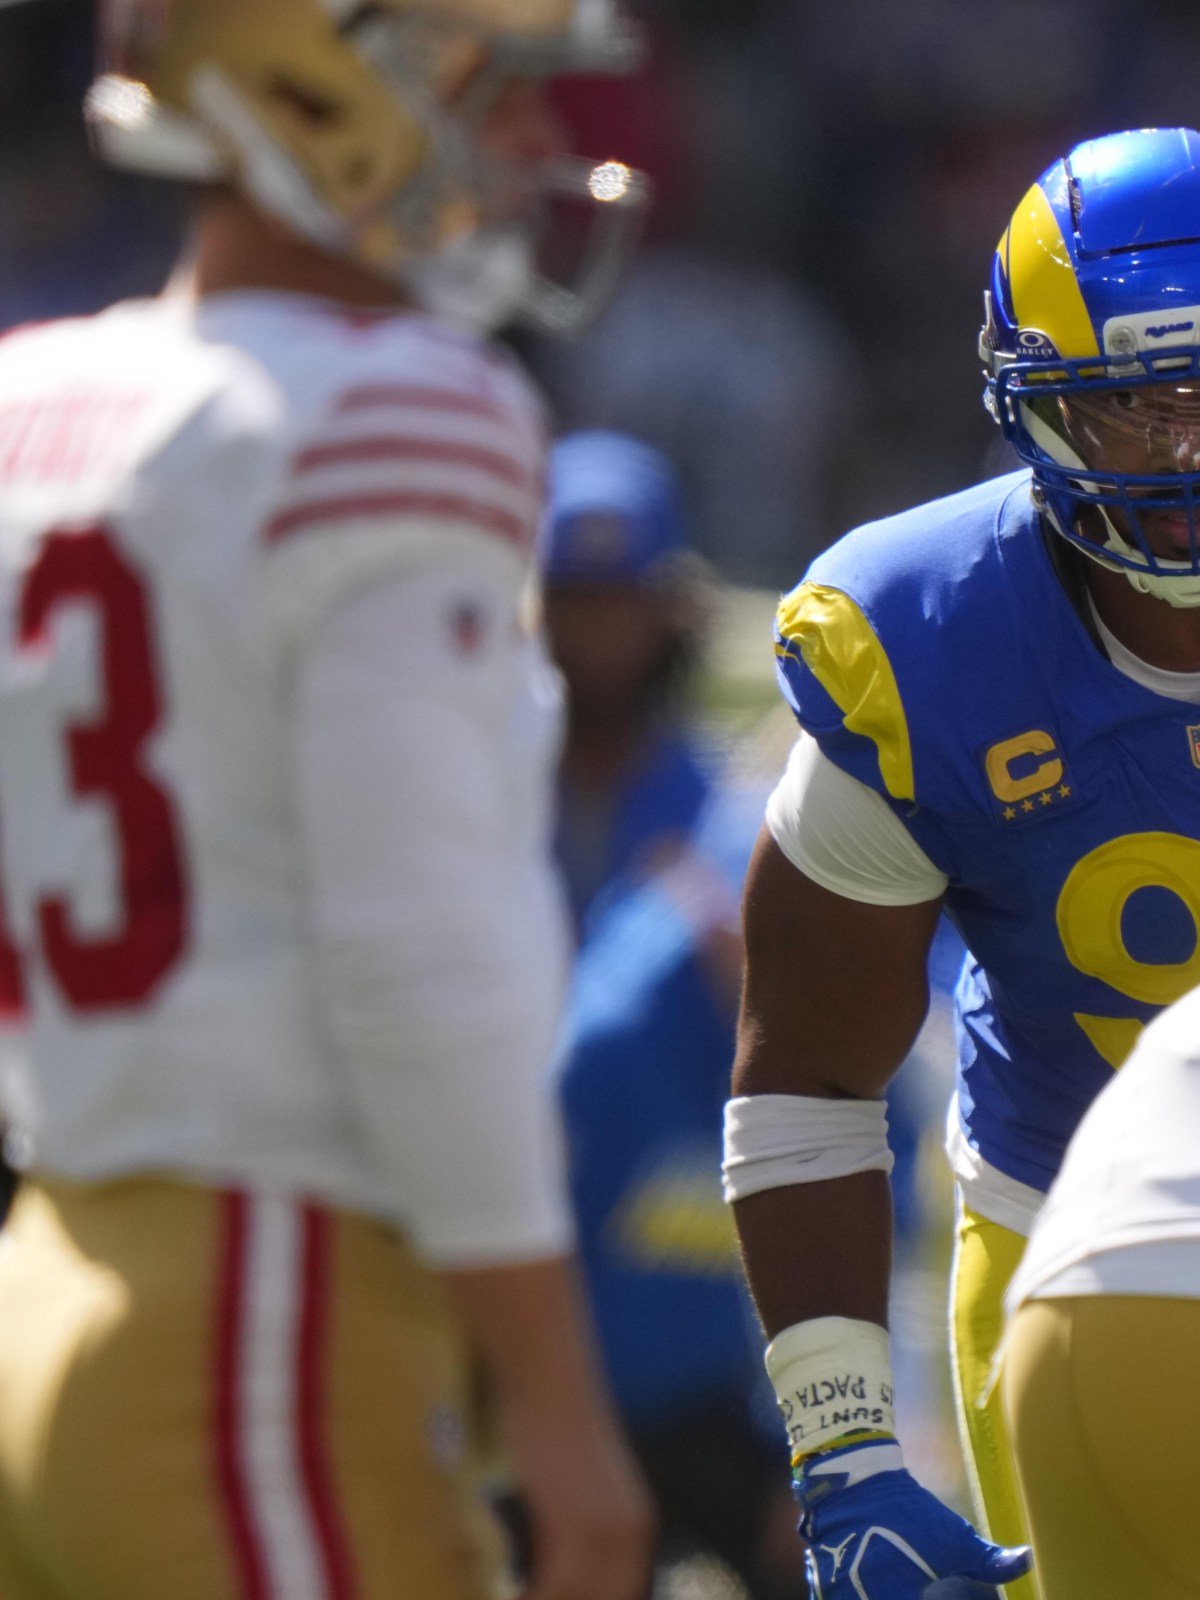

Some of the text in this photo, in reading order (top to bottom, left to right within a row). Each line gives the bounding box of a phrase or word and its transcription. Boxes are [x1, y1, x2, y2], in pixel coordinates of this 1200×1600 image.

[1016, 347, 1053, 355] OAKLEY
[0, 527, 193, 1028] 3
[985, 729, 1064, 803] C
[796, 1375, 866, 1409] PACTA
[820, 1407, 884, 1429] SUNT
